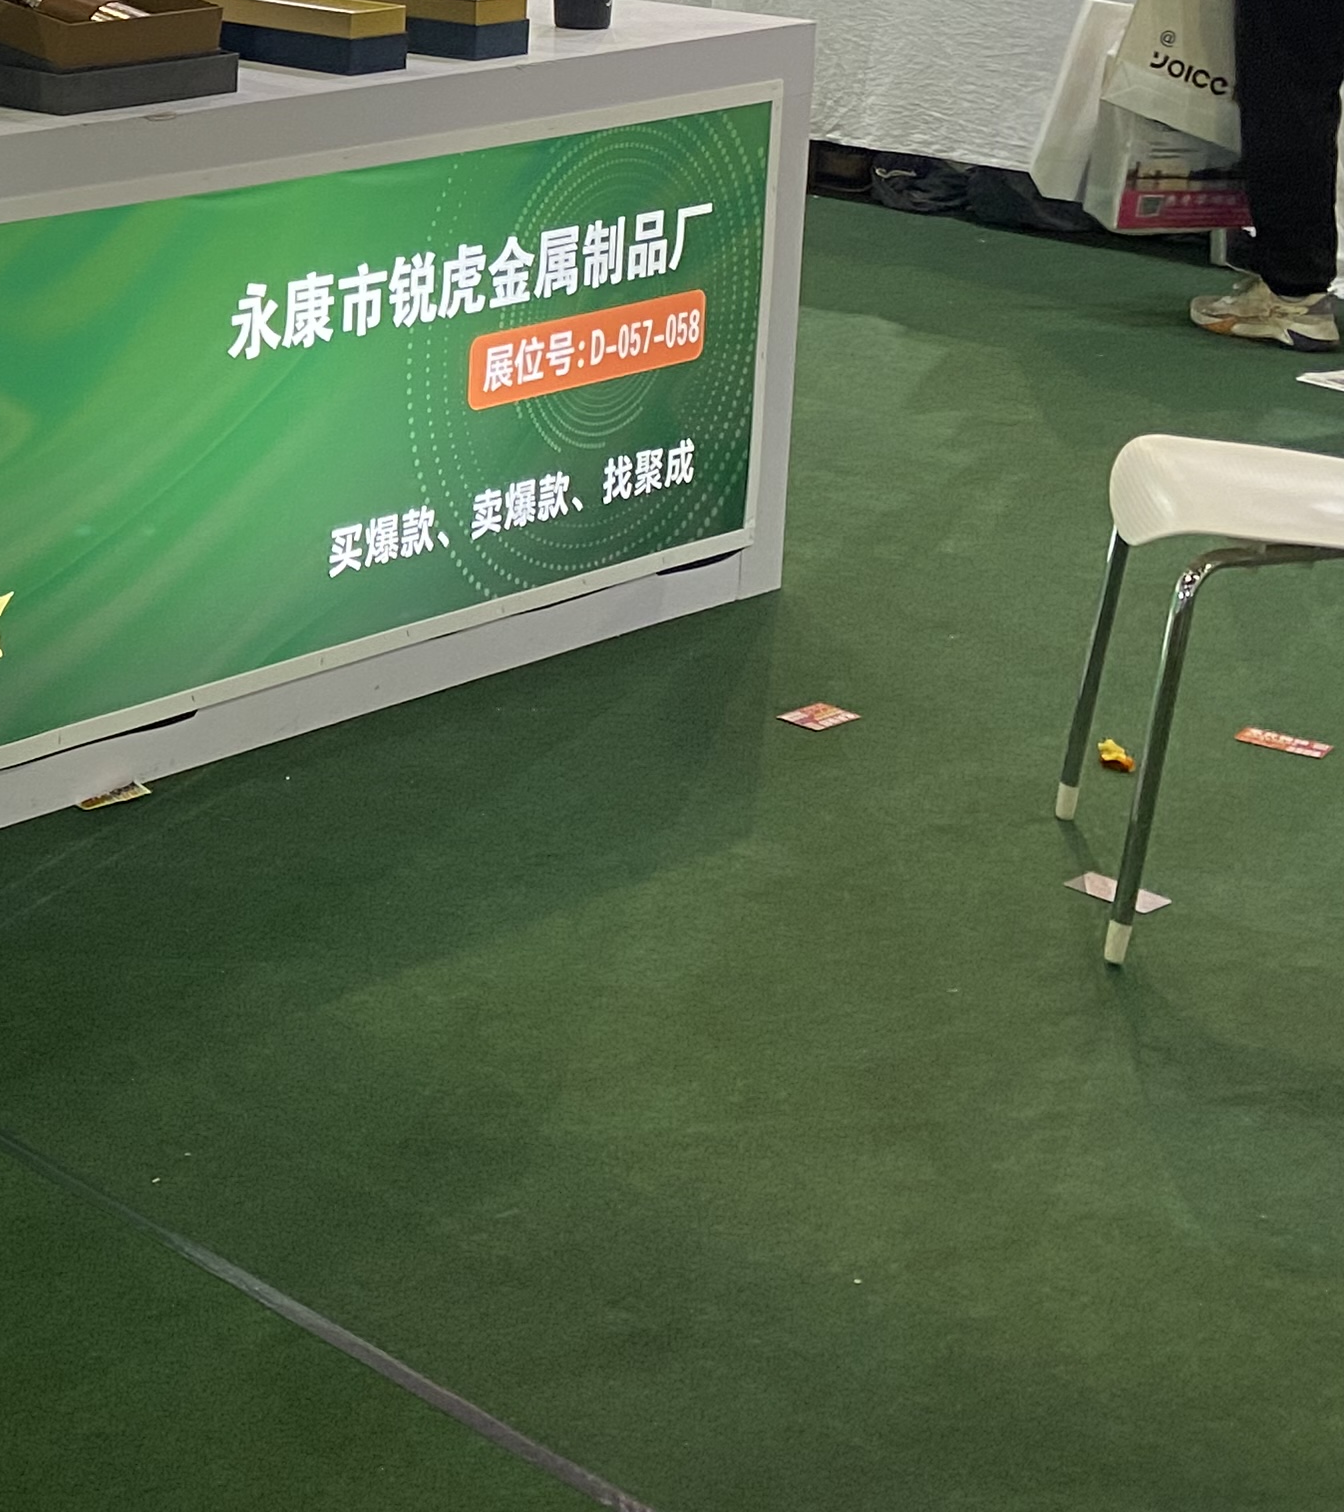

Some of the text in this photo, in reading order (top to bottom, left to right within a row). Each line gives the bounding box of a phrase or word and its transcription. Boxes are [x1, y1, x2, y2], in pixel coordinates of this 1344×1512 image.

[227, 200, 715, 362] 永康市锐虎金属制品厂
[482, 308, 701, 395] 展位号:D-057-058
[327, 438, 695, 580] 买爆款、卖爆款、找聚成
